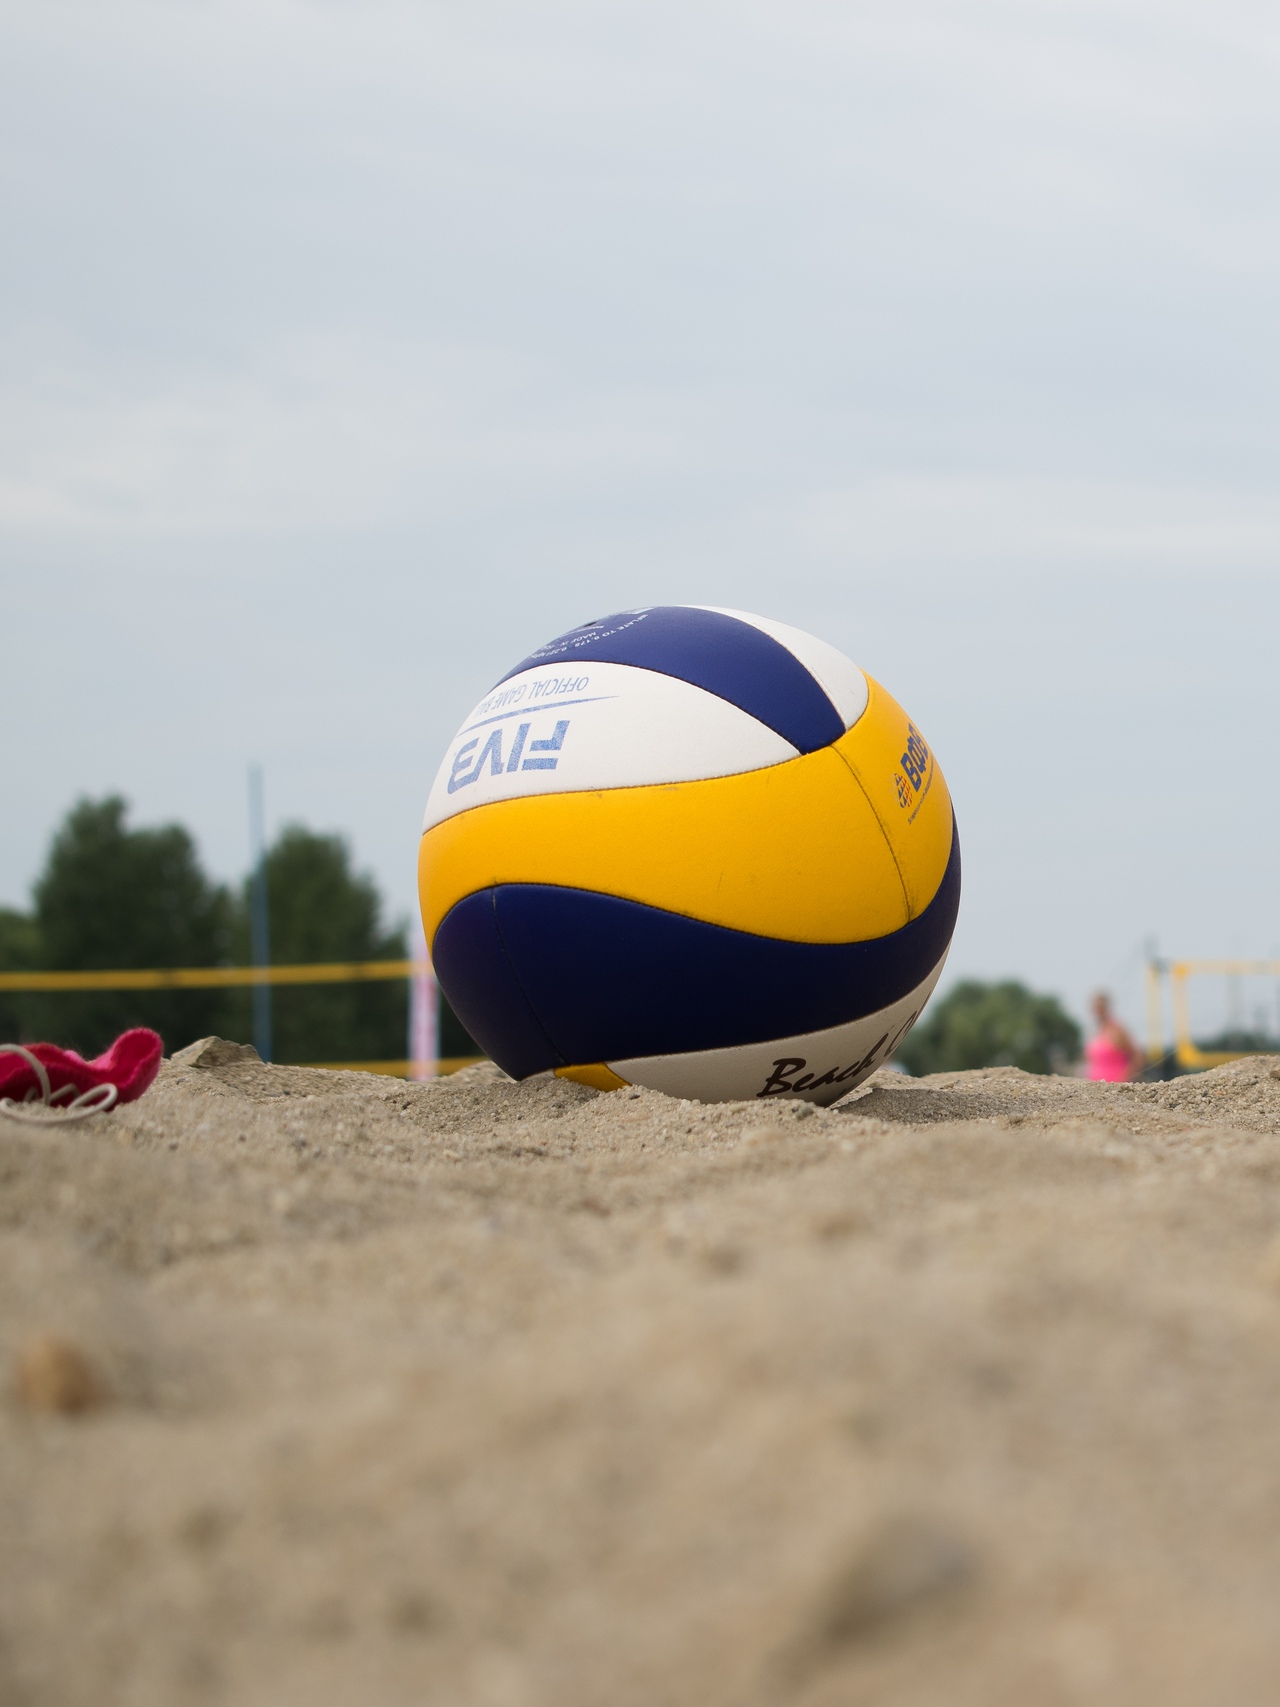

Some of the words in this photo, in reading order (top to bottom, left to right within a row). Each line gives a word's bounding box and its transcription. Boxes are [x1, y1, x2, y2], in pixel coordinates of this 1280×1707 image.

[494, 684, 527, 710] GAME
[528, 677, 589, 700] OFFICIAL
[447, 720, 571, 795] FIVB
[756, 1032, 889, 1097] Beach
